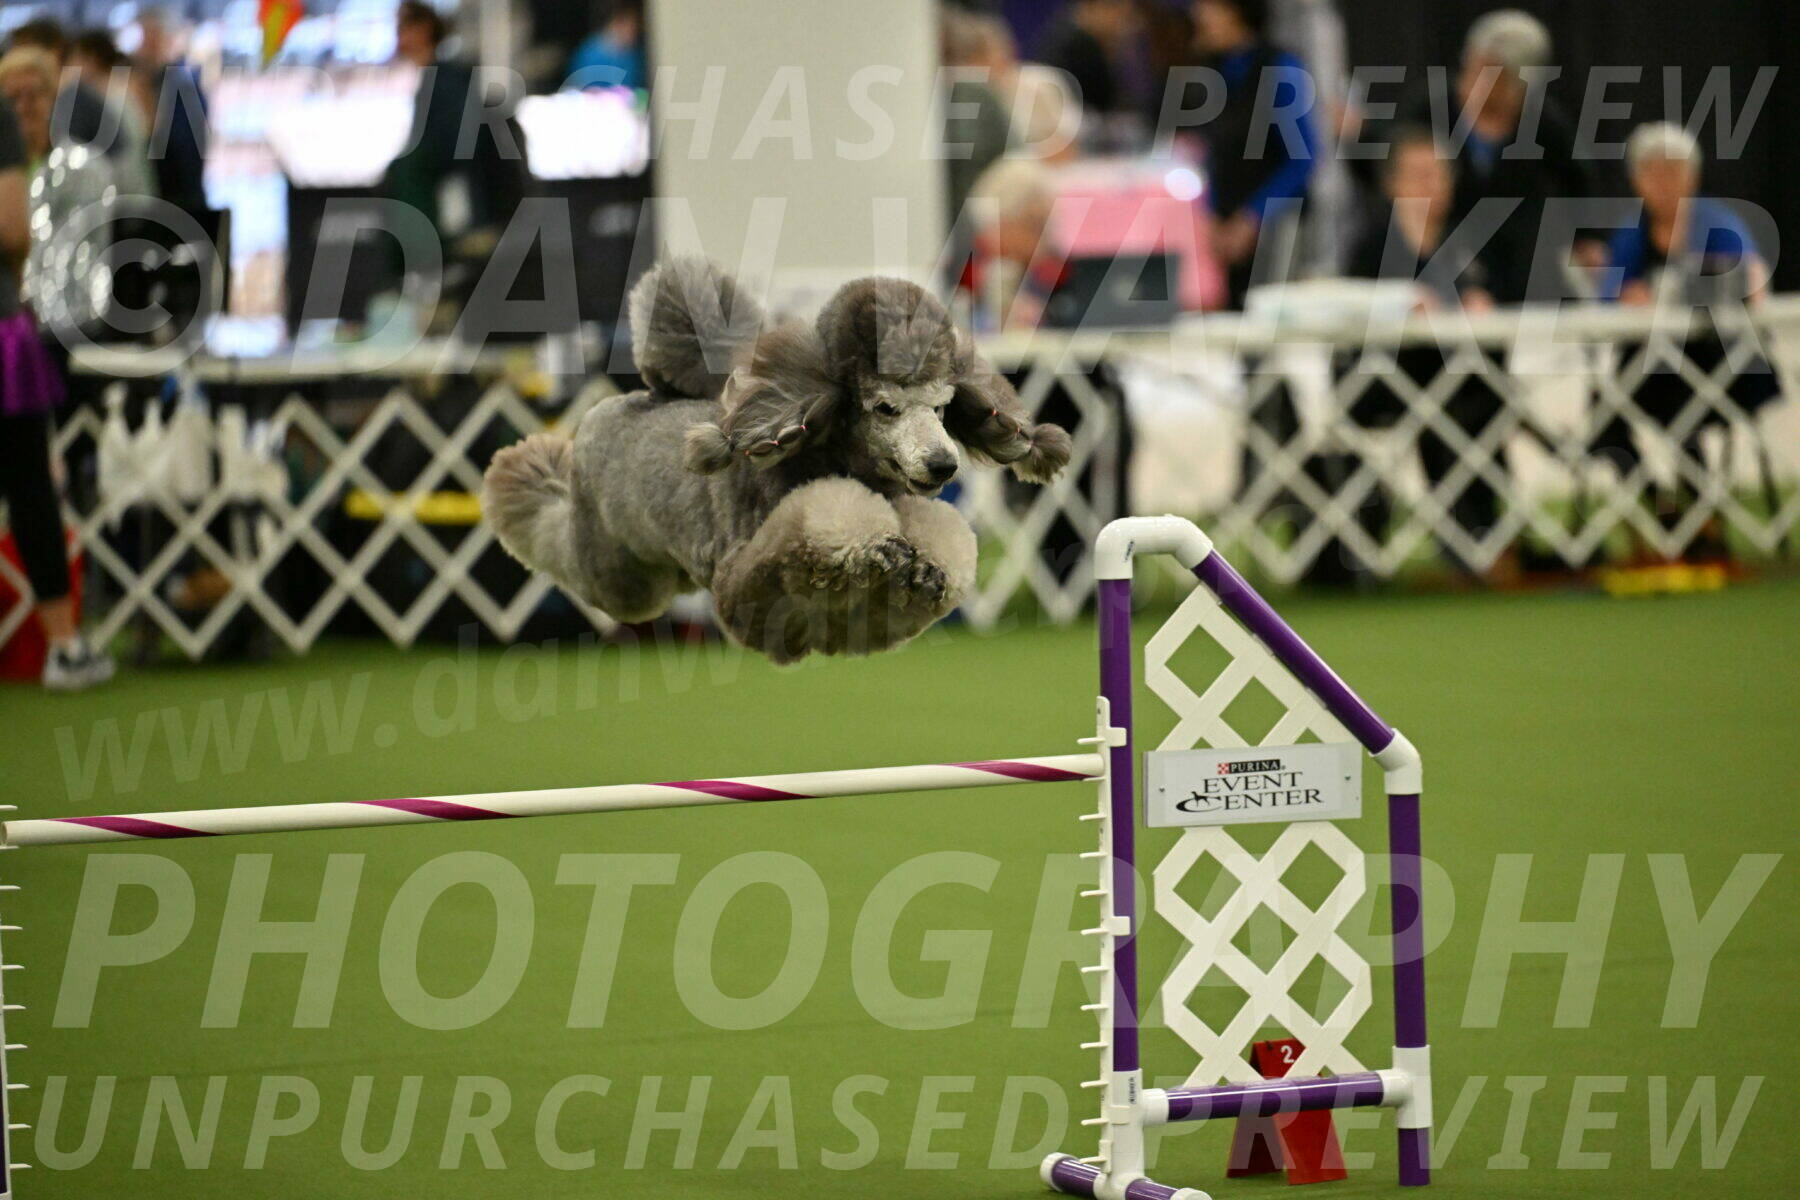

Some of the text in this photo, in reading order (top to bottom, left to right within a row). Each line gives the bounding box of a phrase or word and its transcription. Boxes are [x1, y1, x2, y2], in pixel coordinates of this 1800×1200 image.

[1231, 759, 1281, 774] PURINA
[1203, 771, 1304, 794] EVENT
[1176, 788, 1324, 813] CENTER
[1280, 1044, 1295, 1064] 2
